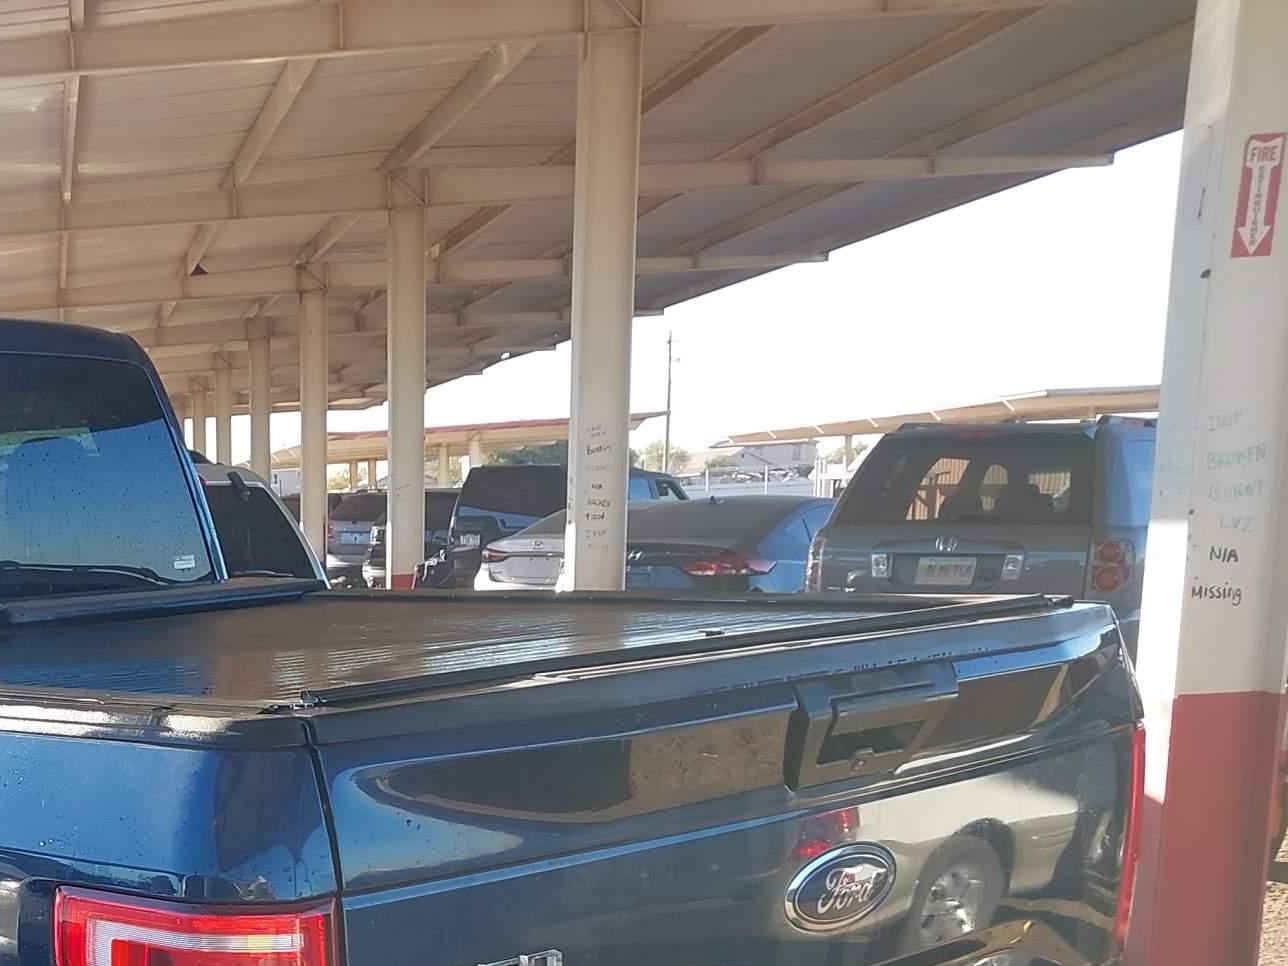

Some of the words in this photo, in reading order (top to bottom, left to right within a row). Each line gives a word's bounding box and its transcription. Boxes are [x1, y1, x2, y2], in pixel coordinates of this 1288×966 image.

[1250, 146, 1277, 162] FIRE
[1209, 546, 1239, 563] N/A
[817, 866, 887, 914] Ford
